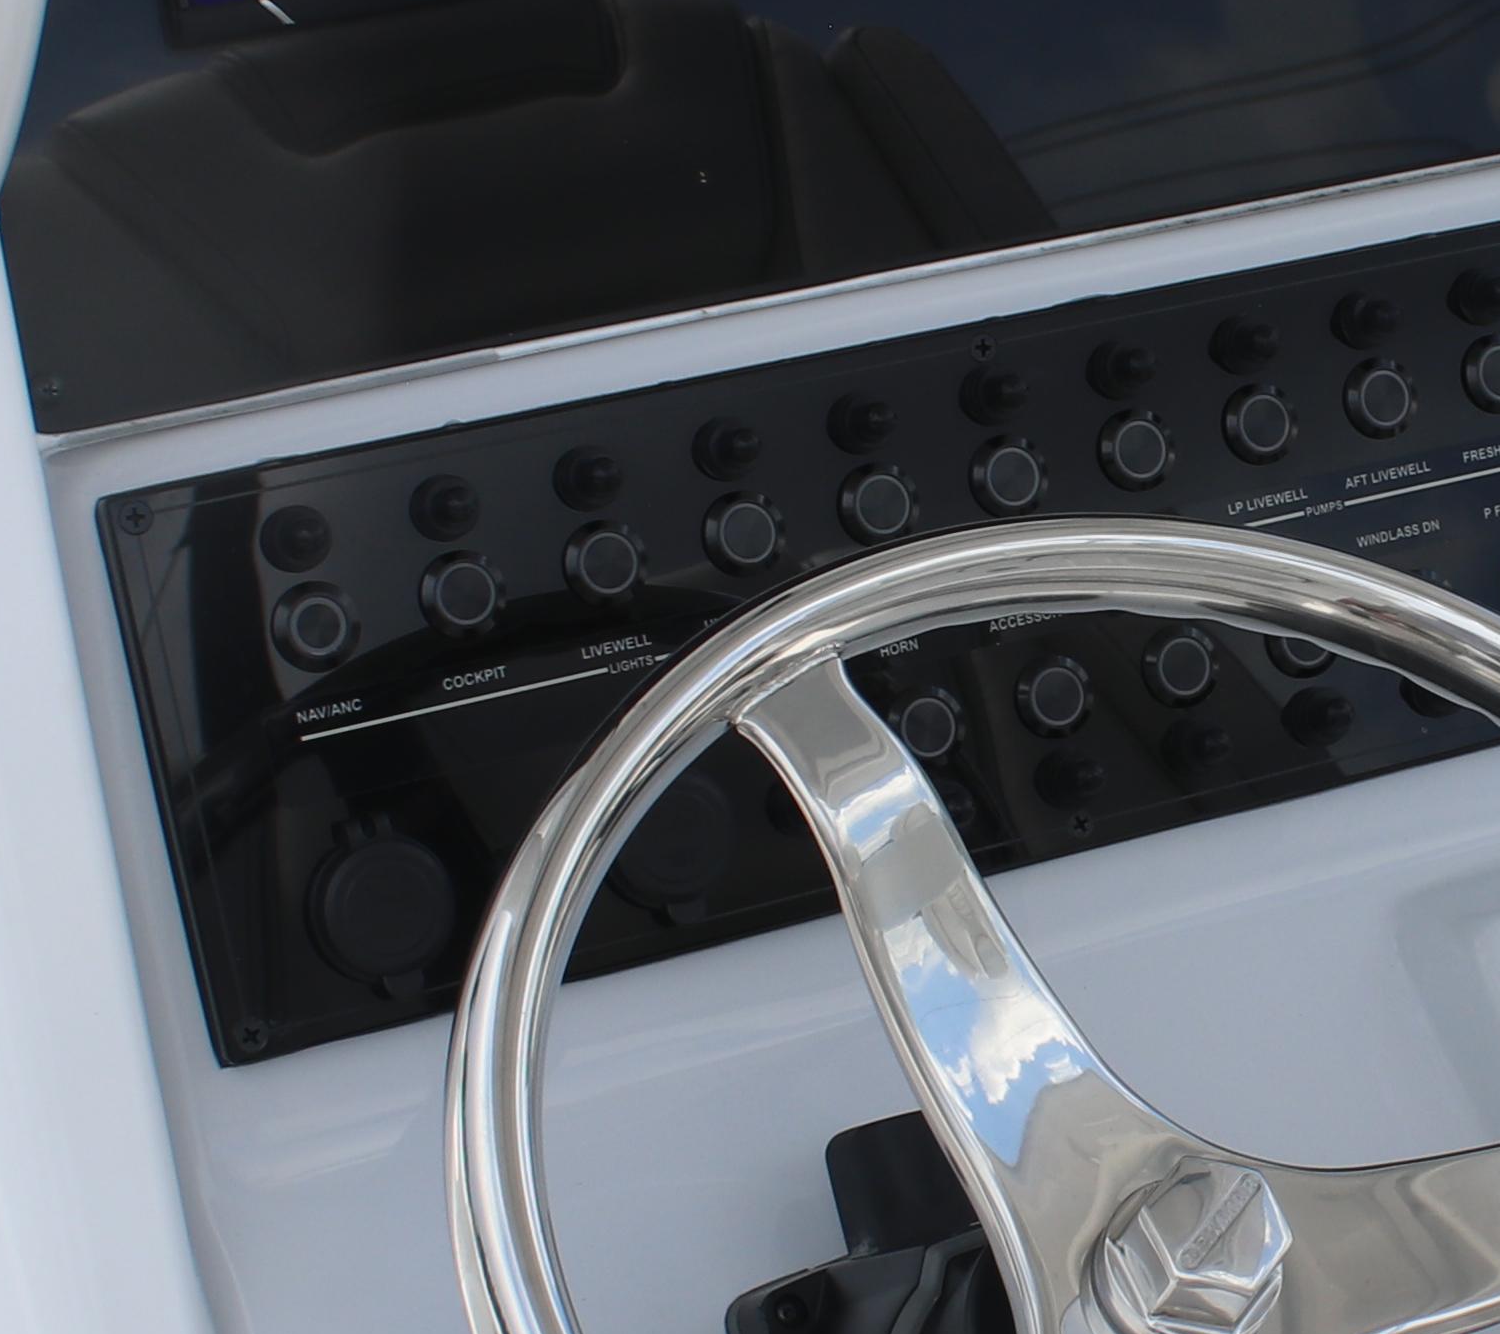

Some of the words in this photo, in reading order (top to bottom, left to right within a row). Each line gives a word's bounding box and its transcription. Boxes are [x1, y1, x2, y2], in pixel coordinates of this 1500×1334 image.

[1344, 472, 1369, 490] AFT
[1370, 461, 1432, 485] LIVEWELL
[1227, 499, 1243, 516] LP
[1245, 487, 1309, 512] LIVEWELL
[1305, 499, 1344, 518] PUMPS
[1483, 506, 1493, 519] P
[1356, 524, 1419, 549] WINDLASS
[1421, 519, 1441, 535] DN
[581, 634, 653, 660] LIVEWELL
[880, 638, 920, 658] HORN
[608, 654, 655, 676] LIGHTS
[442, 666, 507, 692] COCKPIT
[296, 698, 363, 725] NAV/ANC
